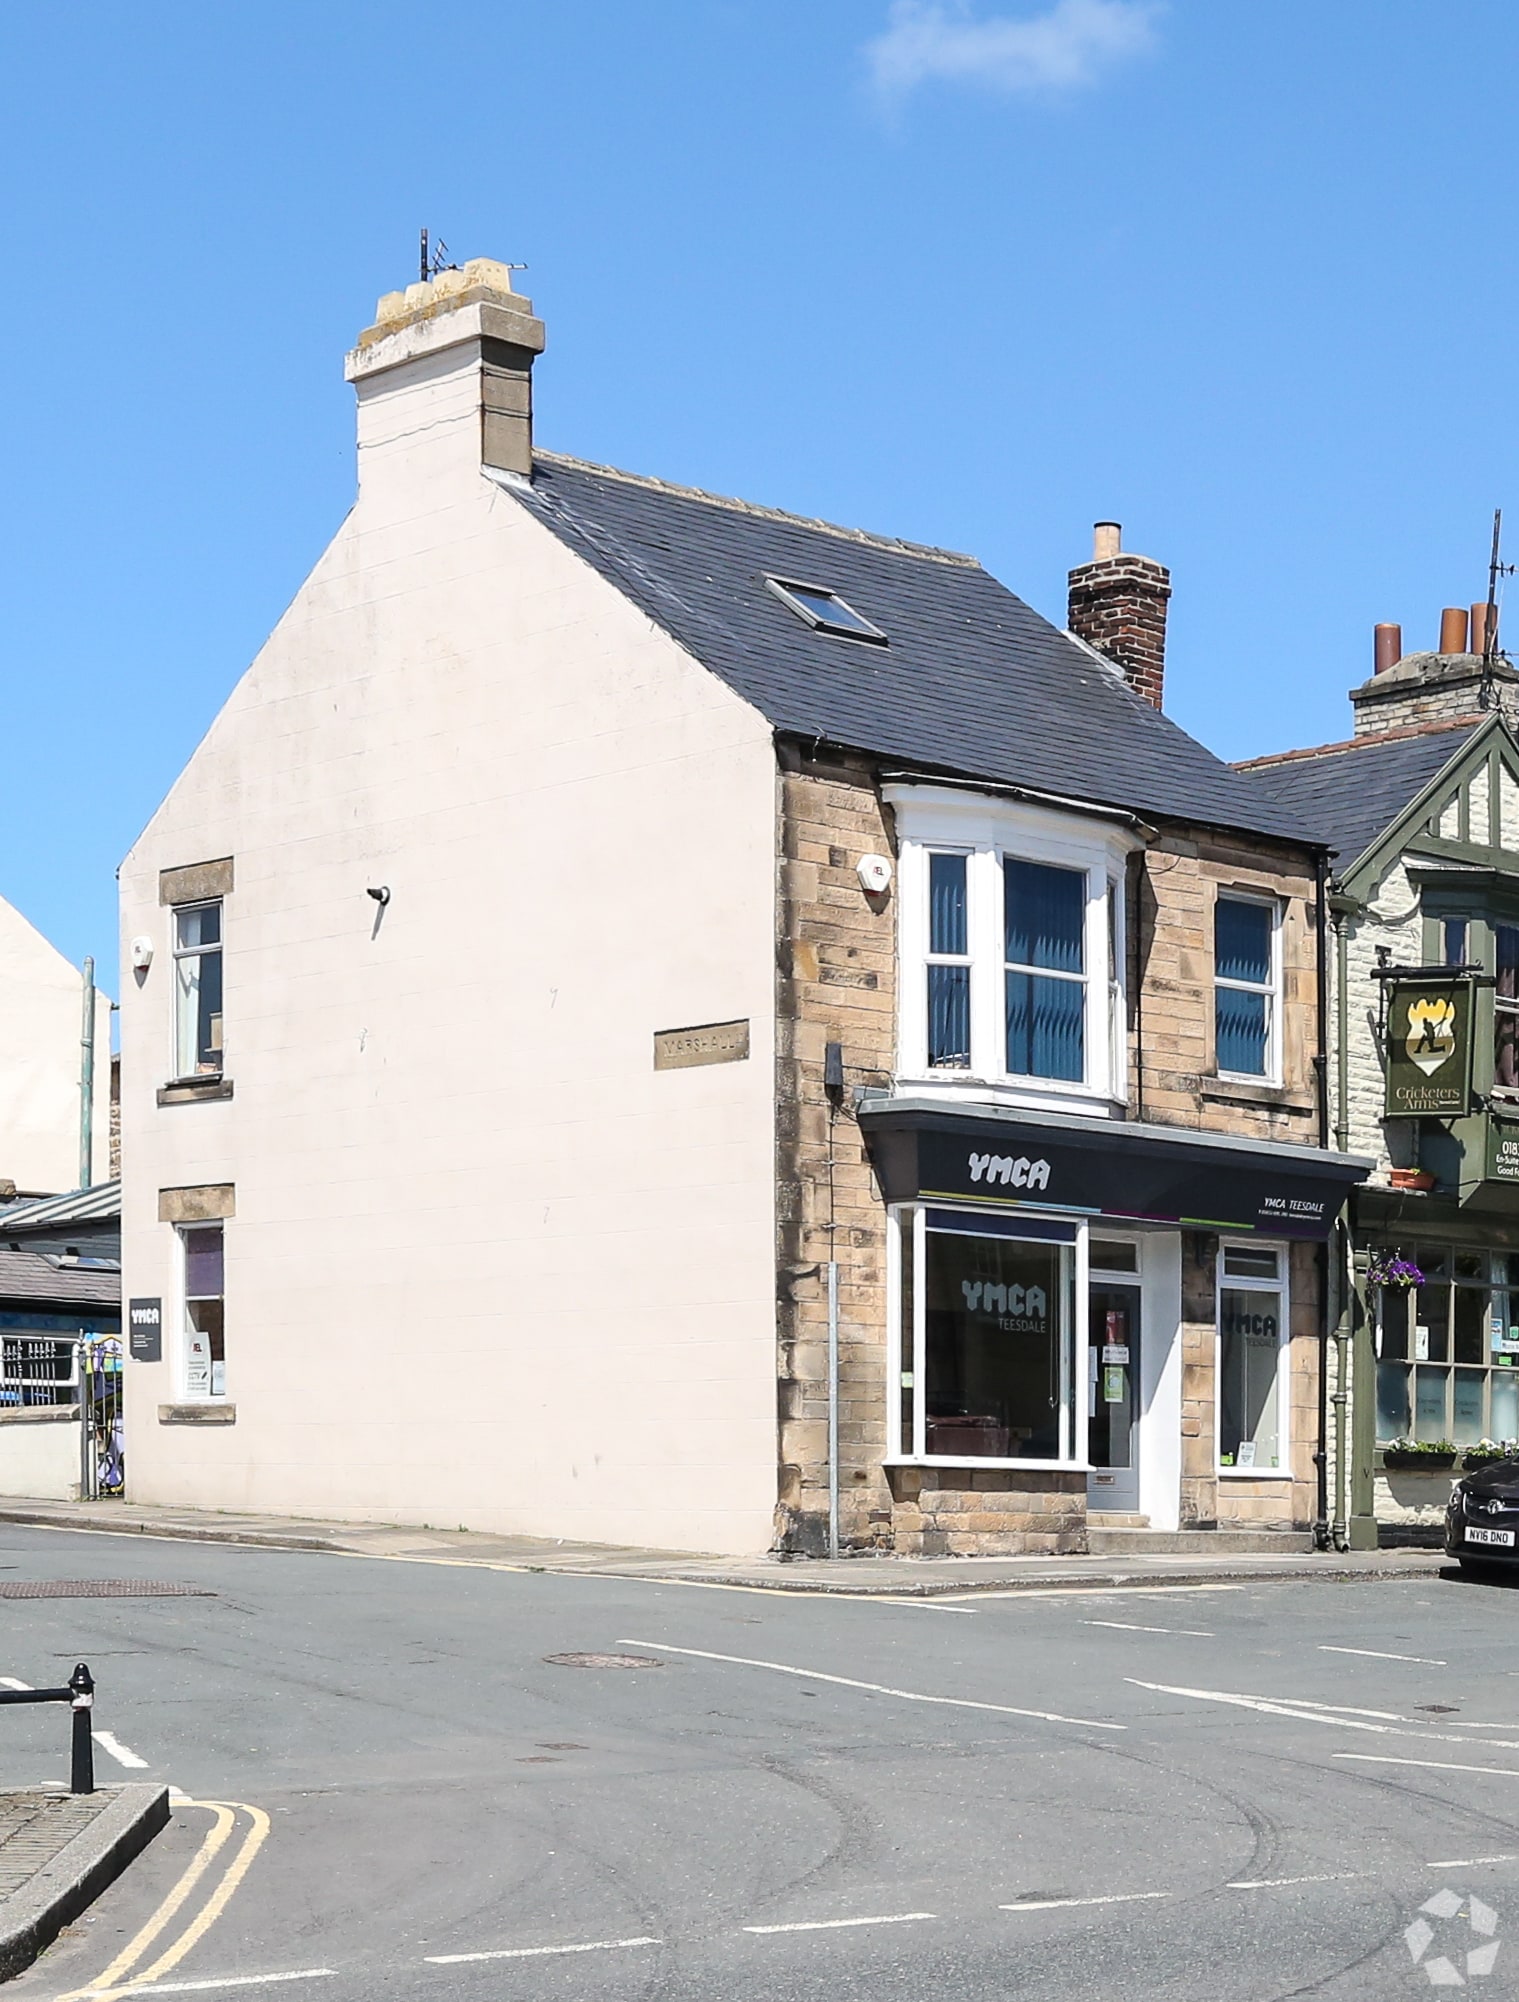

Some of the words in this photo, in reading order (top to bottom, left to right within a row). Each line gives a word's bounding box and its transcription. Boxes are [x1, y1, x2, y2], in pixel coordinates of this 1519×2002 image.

[1396, 1086, 1460, 1100] Cricketers
[1404, 1099, 1440, 1110] Arms
[1502, 1140, 1519, 1156] 018
[968, 1152, 1051, 1191] YMCA
[1497, 1165, 1514, 1176] Good
[1265, 1197, 1286, 1209] YMCA
[1290, 1200, 1325, 1213] TEESDALE
[962, 1280, 1046, 1318] YMCA
[131, 1308, 160, 1324] YMCA
[999, 1318, 1046, 1333] TEESDALE
